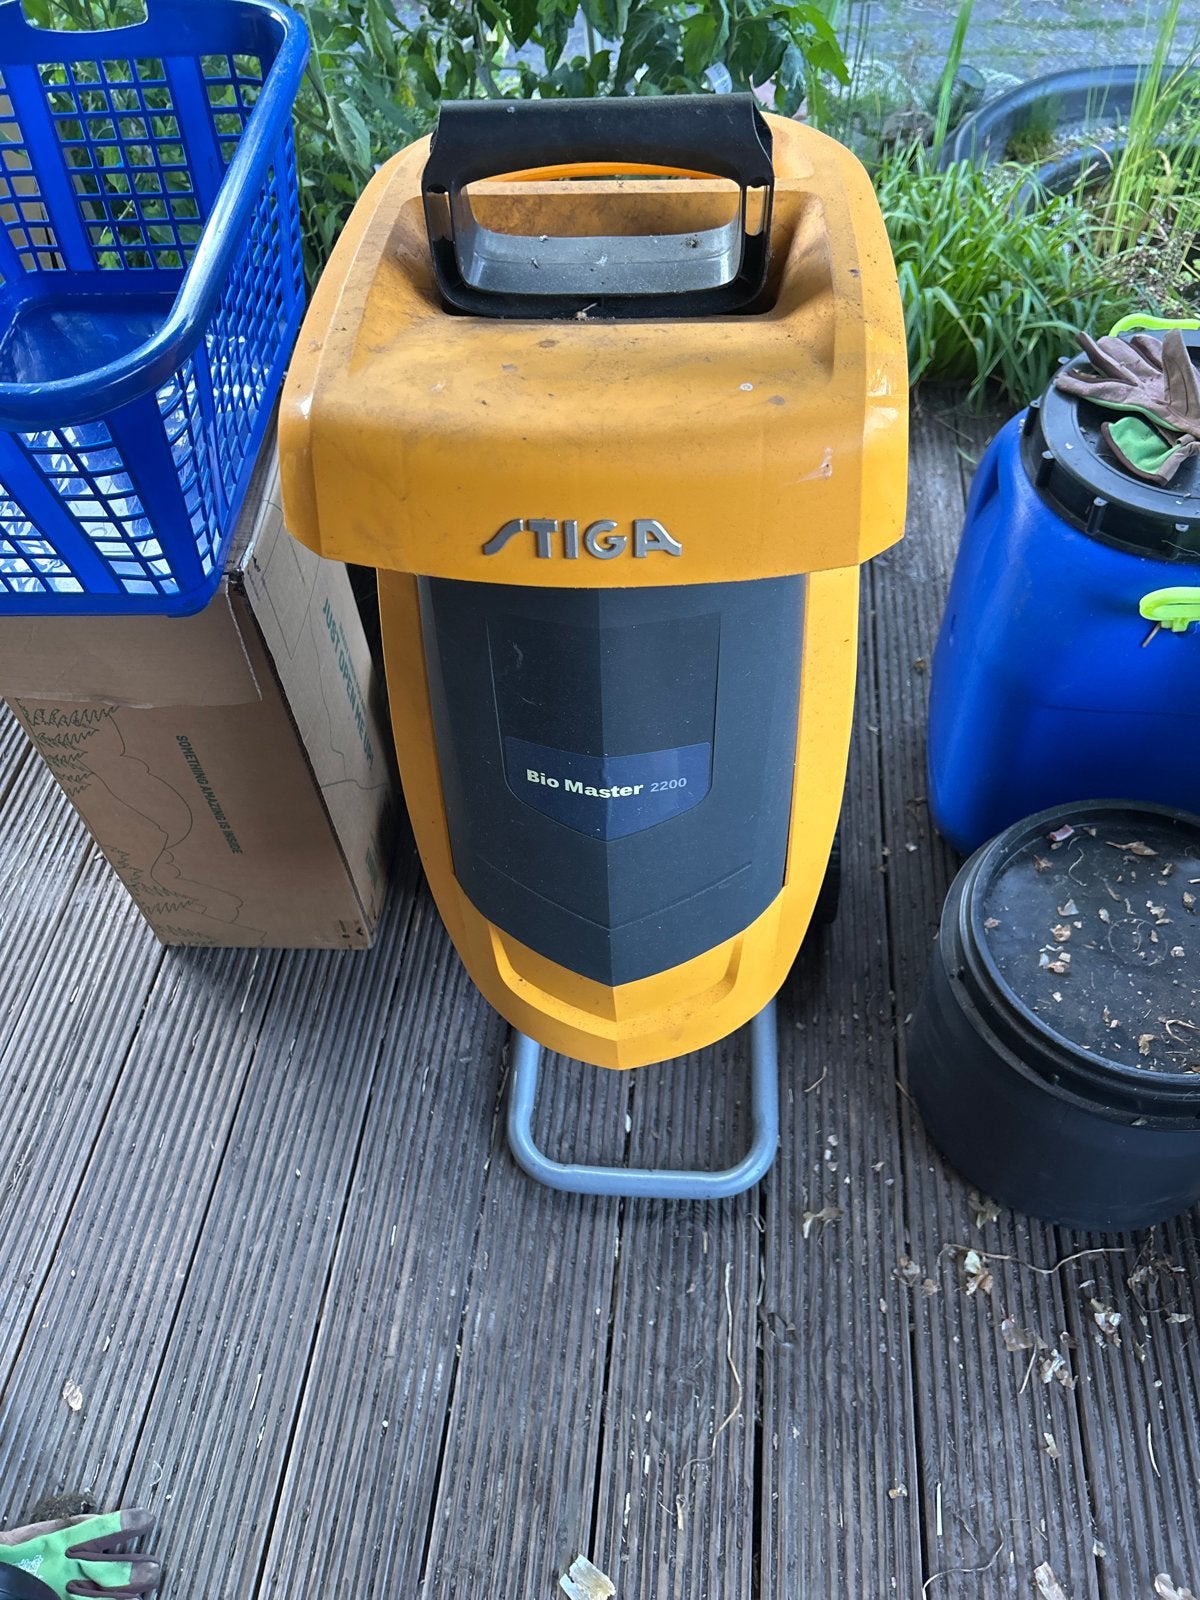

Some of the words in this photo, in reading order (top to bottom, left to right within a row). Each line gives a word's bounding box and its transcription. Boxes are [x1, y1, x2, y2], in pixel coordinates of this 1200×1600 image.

[482, 518, 683, 559] STIGA
[323, 596, 340, 653] JUST
[339, 649, 357, 711] OPEN
[355, 703, 365, 741] ME
[176, 735, 208, 785] SOMETHING
[200, 785, 226, 821] AMAZING
[222, 830, 243, 854] INSIDE
[526, 769, 560, 788] Bio
[564, 778, 644, 799] Master
[650, 777, 687, 793] 2200
